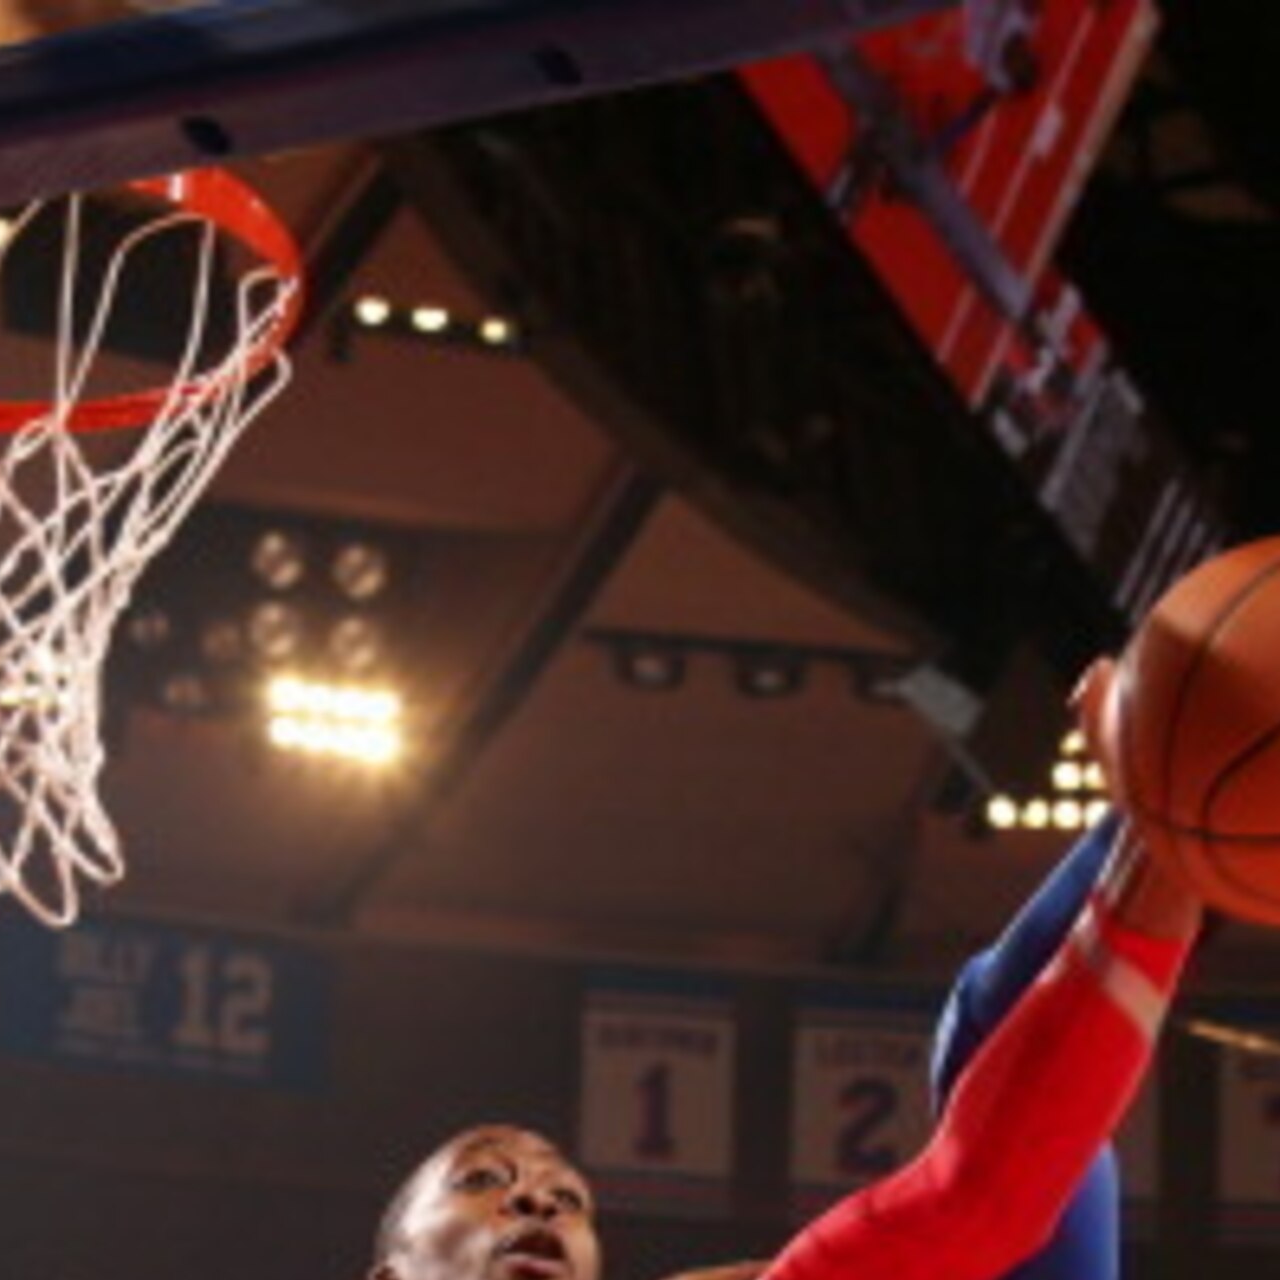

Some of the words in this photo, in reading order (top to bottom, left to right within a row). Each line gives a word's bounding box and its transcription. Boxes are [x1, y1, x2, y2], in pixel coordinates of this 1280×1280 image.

[170, 942, 275, 1056] 12
[632, 1058, 677, 1160] 1
[834, 1075, 902, 1178] 2
